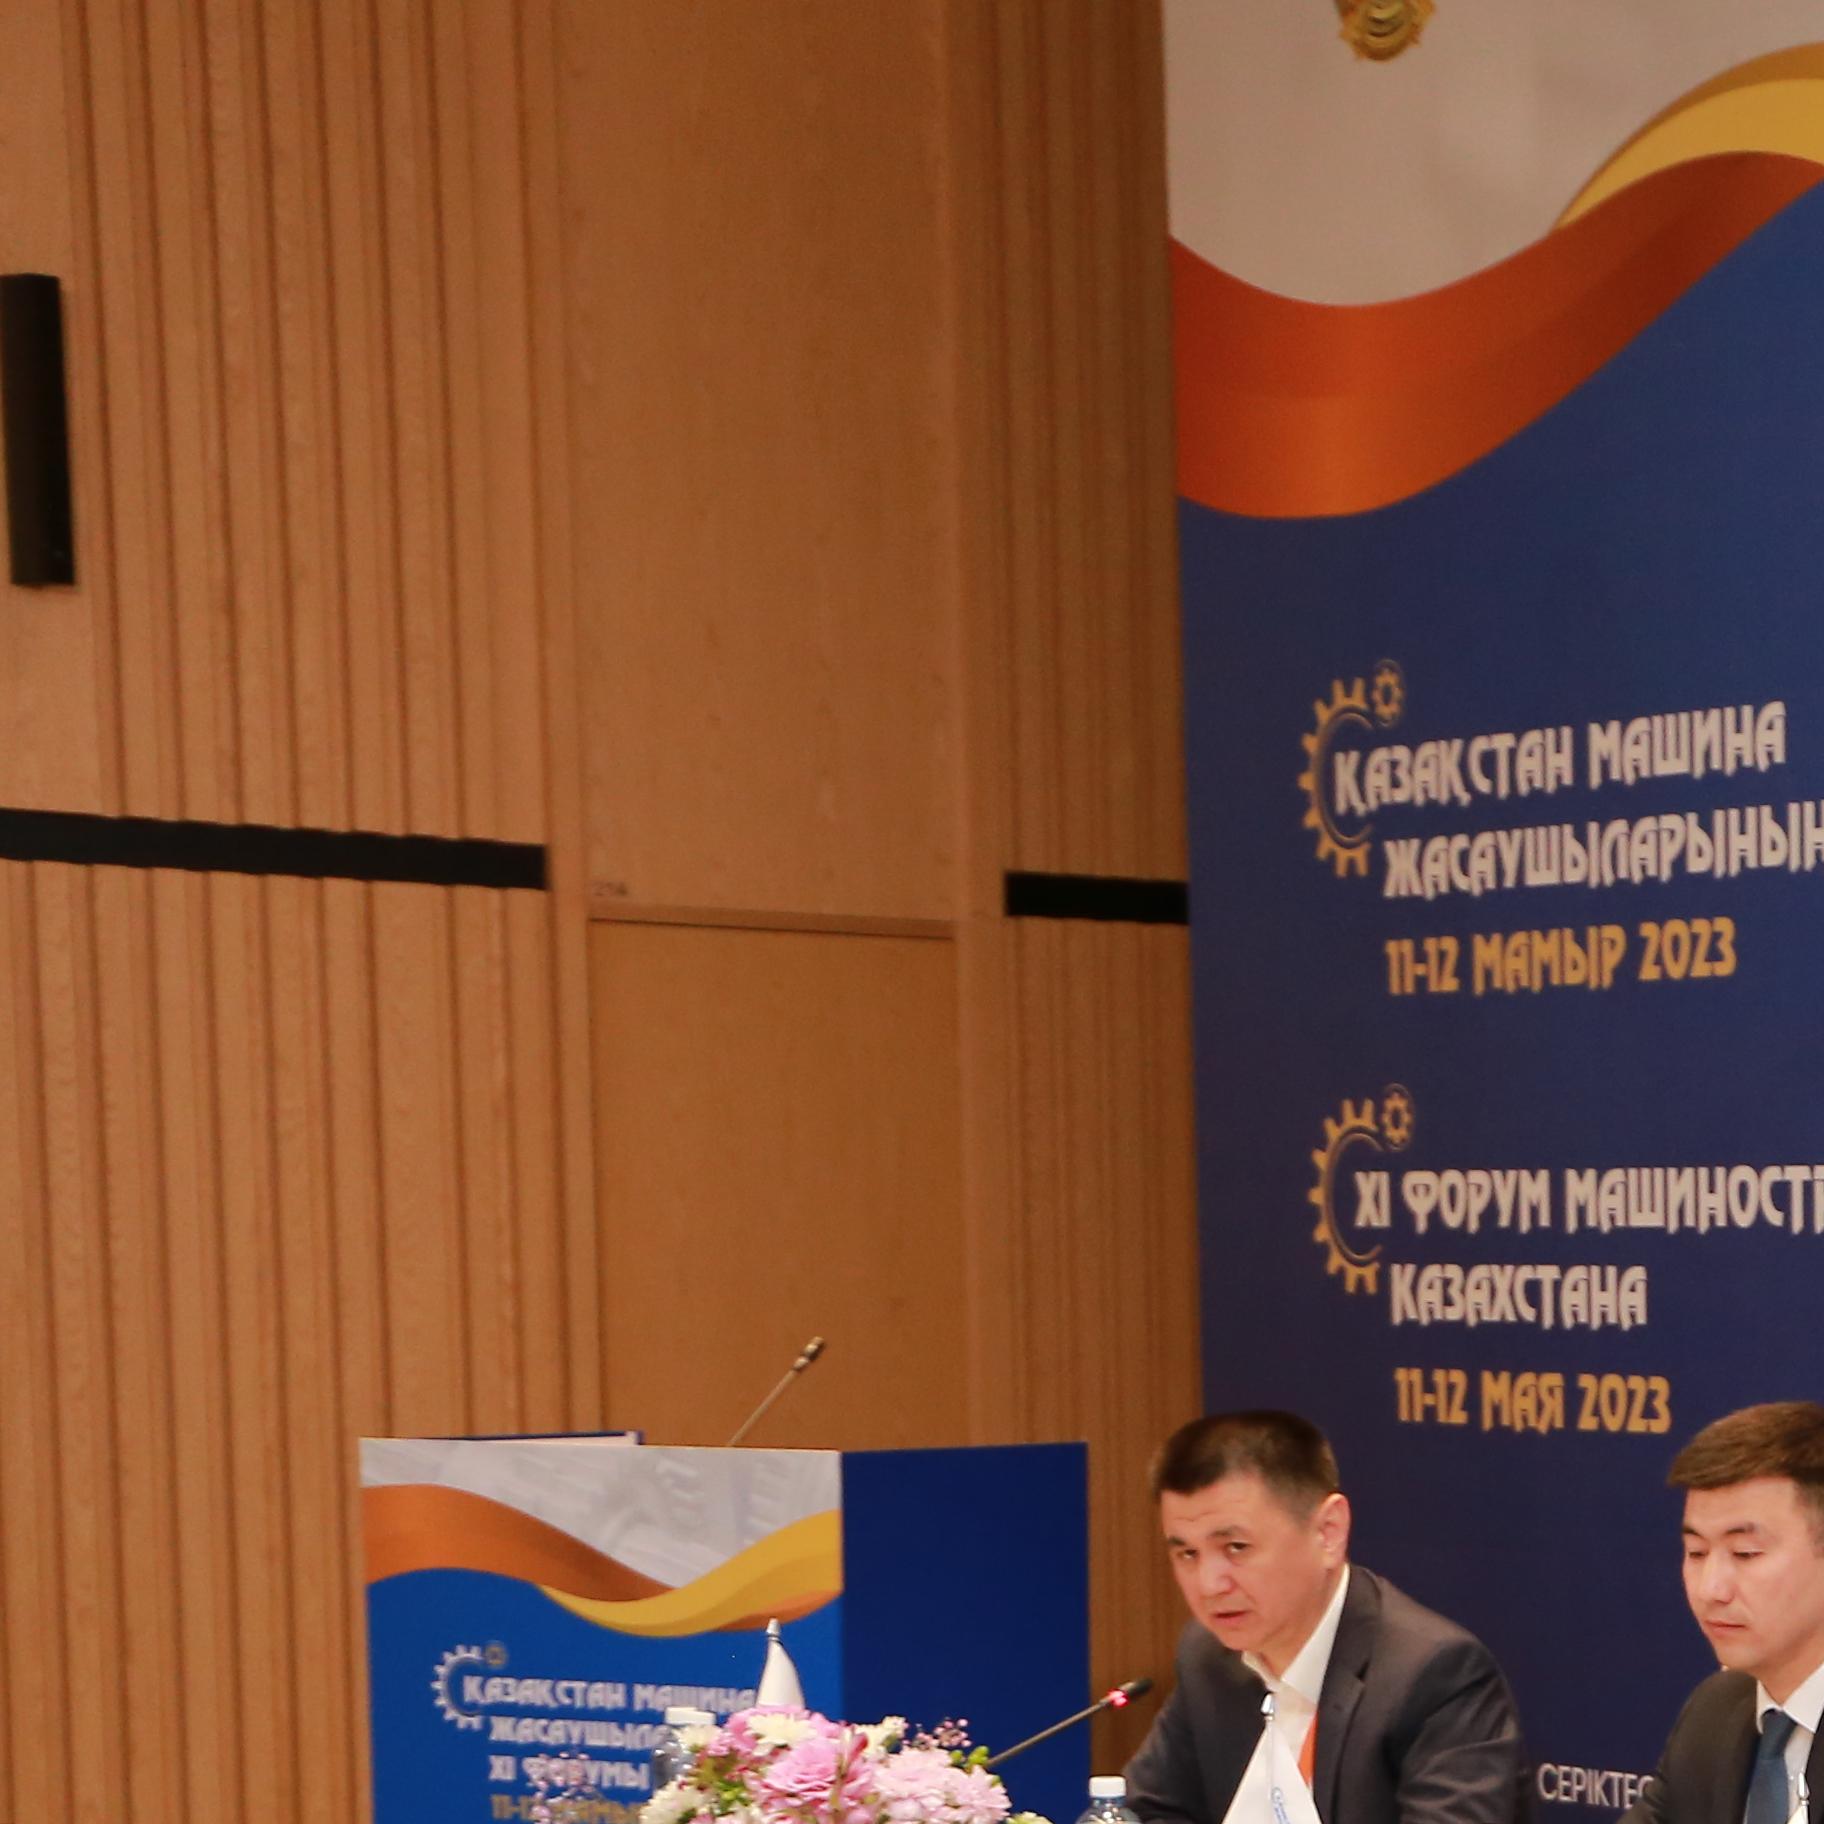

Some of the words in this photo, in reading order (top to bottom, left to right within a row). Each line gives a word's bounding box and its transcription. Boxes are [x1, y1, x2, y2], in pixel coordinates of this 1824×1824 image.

[1334, 726, 1573, 815] ҚАЗАҚСТАН
[1588, 701, 1786, 791] МАШИНА
[1386, 936, 1458, 995] 11-12
[1473, 925, 1626, 995] МАМЫР
[1640, 917, 1736, 981] 2023
[1403, 1168, 1550, 1231] ФОРУМ
[1391, 1262, 1647, 1330] КАЗАХСТАНА
[1395, 1367, 1467, 1424] 11-12
[1483, 1371, 1564, 1433] МАЯ
[1578, 1375, 1670, 1433] 2023
